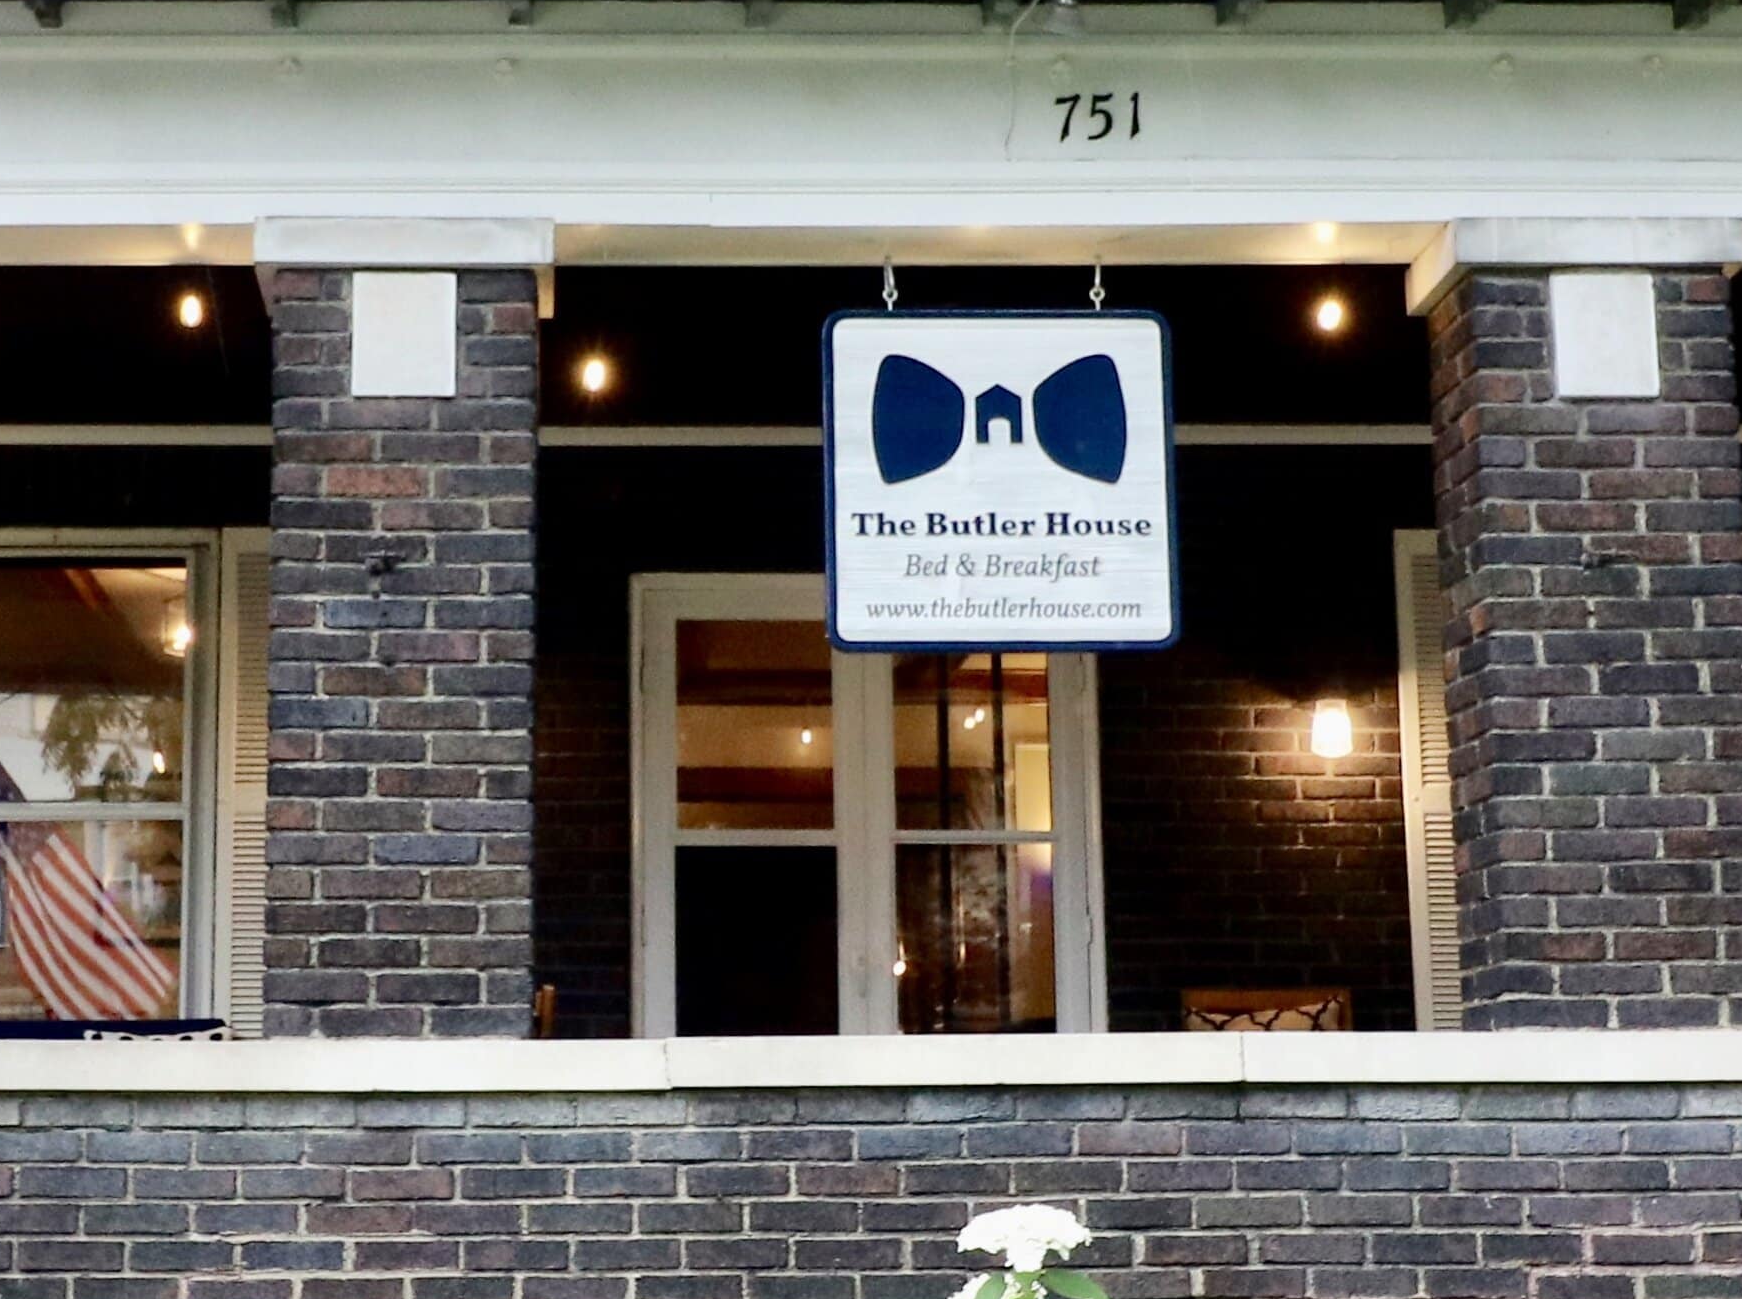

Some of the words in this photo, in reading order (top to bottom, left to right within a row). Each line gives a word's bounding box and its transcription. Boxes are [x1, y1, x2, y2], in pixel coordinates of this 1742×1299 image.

[1054, 90, 1140, 143] 751
[851, 513, 917, 537] The
[925, 513, 1036, 537] Butler
[1045, 513, 1152, 537] House
[904, 554, 948, 577] Bed
[955, 556, 976, 577] &
[985, 553, 1101, 583] Breakfast
[866, 598, 1142, 619] www.thebutlerhouse.com
